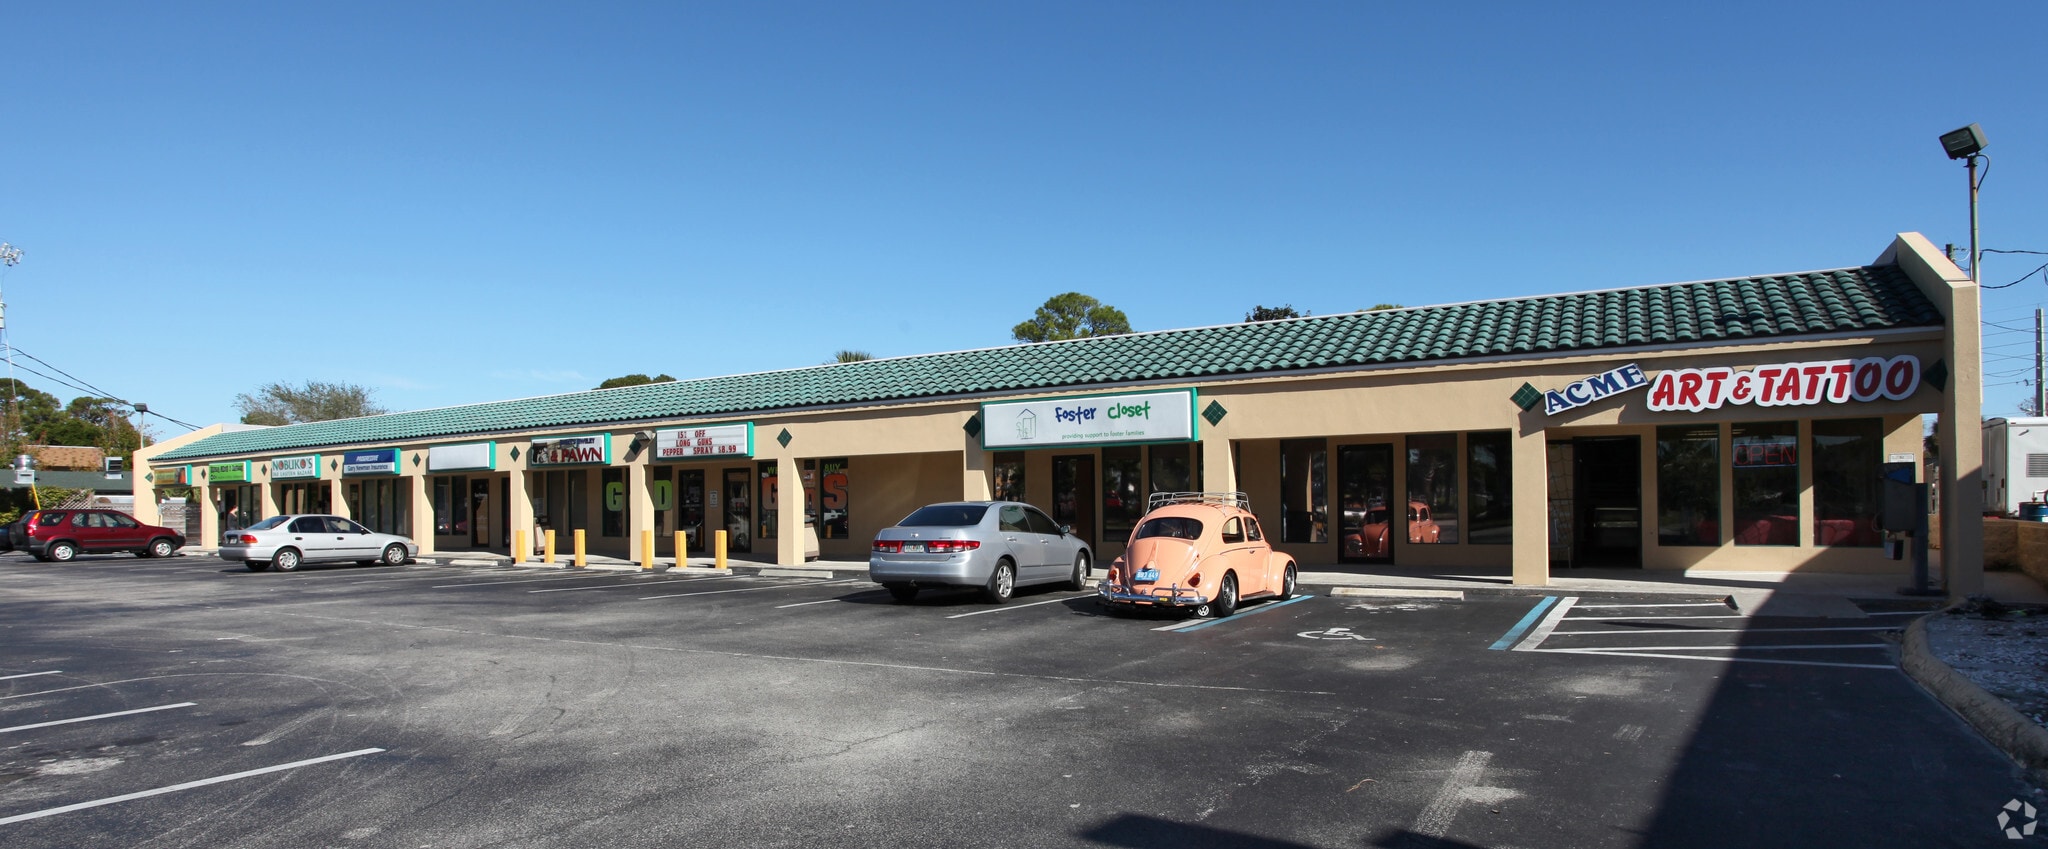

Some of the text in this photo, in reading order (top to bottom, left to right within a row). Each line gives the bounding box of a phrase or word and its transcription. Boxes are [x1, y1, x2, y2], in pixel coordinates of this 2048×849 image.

[1546, 364, 1645, 413] ACME
[1652, 360, 1913, 407] ART & TATTOO
[694, 429, 706, 438] OFF
[676, 438, 713, 447] LONG GUNS
[551, 446, 603, 462] & PAWN
[662, 445, 737, 456] PEPPER SPRAY $8.99
[1735, 443, 1797, 465] OPEN
[272, 458, 312, 470] NOBUKO'S
[824, 463, 841, 473] BUY
